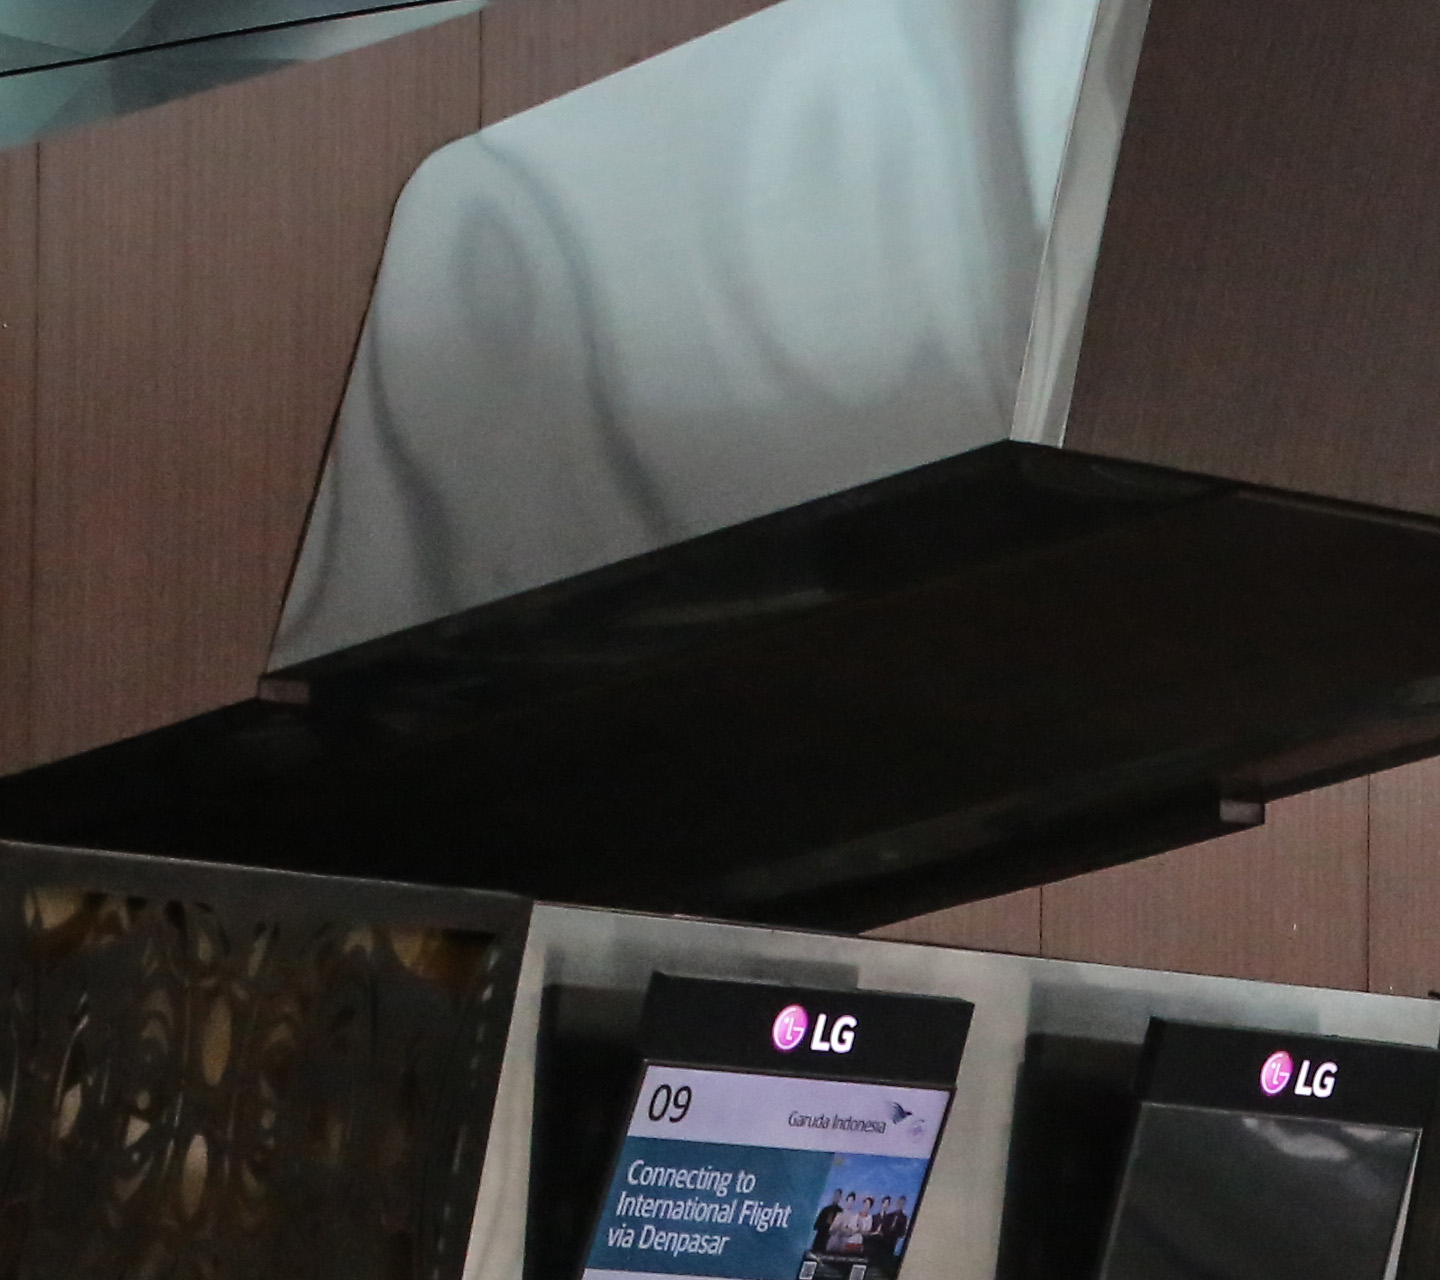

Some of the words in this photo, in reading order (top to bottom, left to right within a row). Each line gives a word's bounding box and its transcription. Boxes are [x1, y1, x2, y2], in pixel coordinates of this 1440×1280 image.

[811, 1013, 855, 1053] LG
[1294, 1059, 1338, 1098] LG
[648, 1084, 692, 1123] 09
[788, 1111, 828, 1129] Garuda
[831, 1114, 886, 1134] Indonesia
[627, 1158, 731, 1196] Connecting
[737, 1170, 755, 1193] to
[616, 1192, 736, 1224] International
[738, 1201, 791, 1231] Flight
[607, 1225, 633, 1248] via
[638, 1226, 729, 1256] Denpasar
